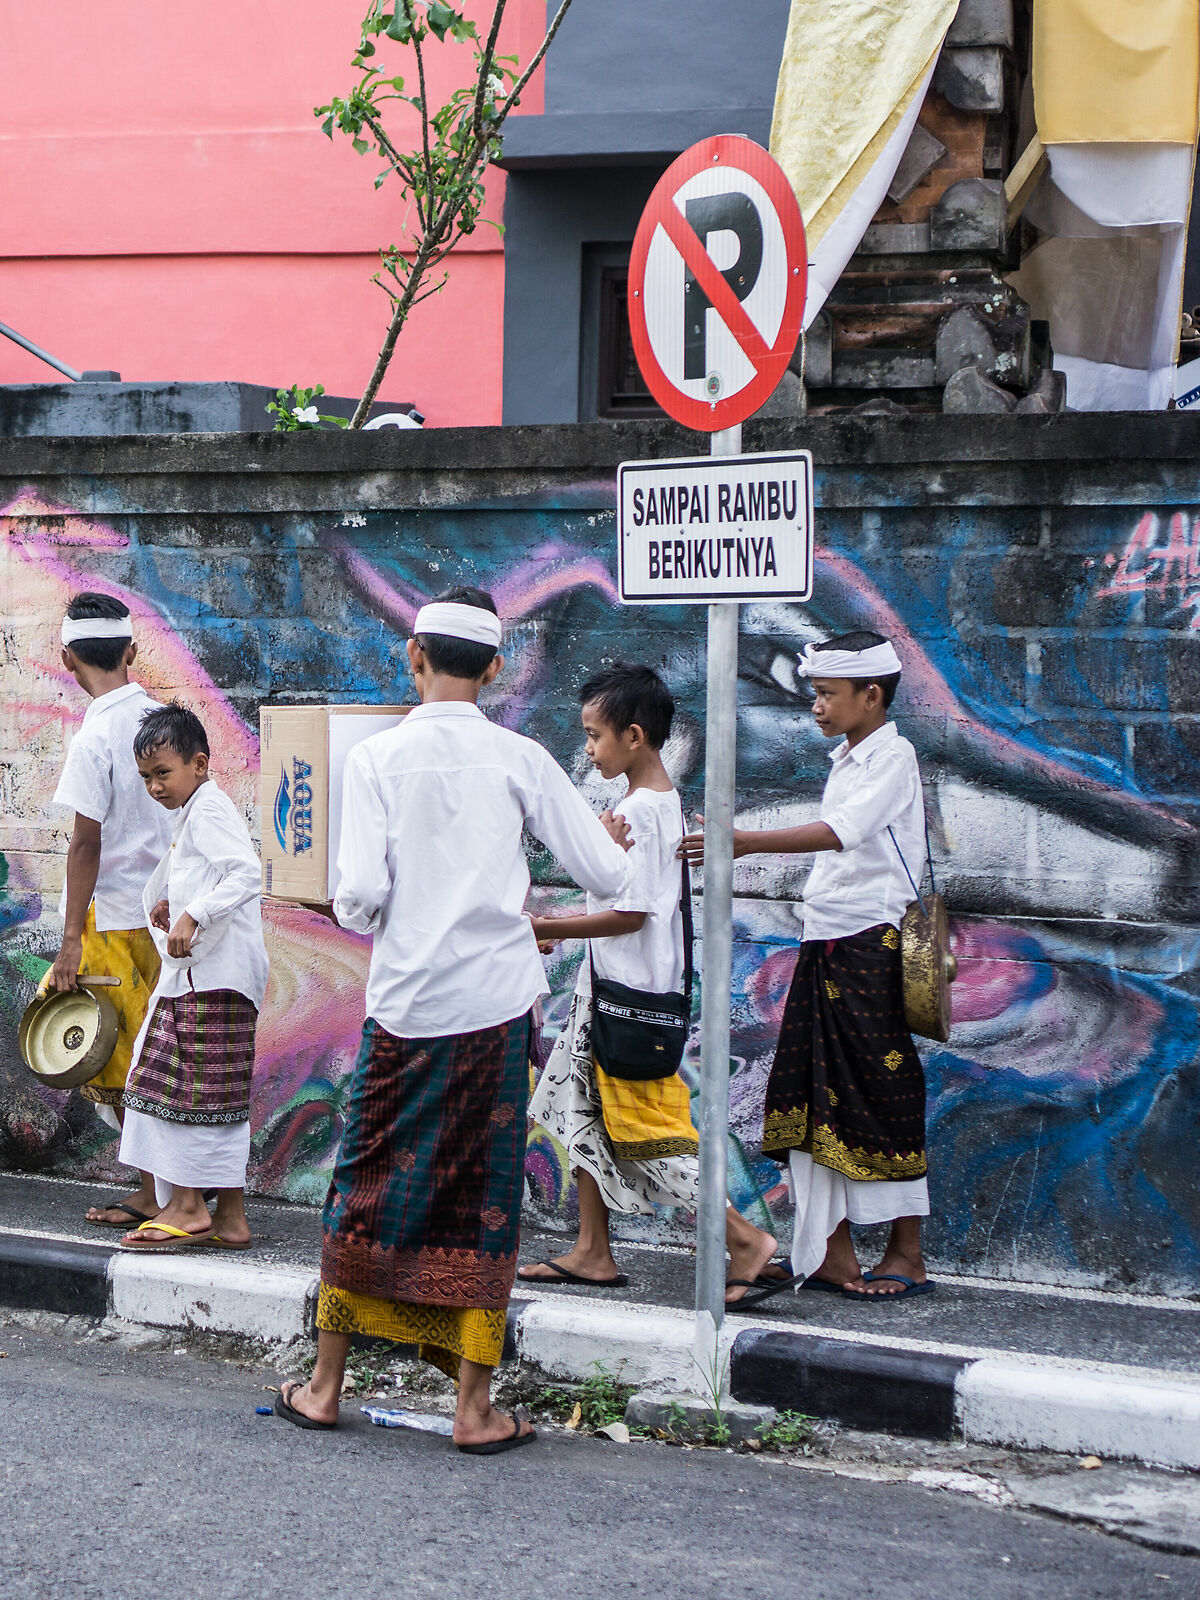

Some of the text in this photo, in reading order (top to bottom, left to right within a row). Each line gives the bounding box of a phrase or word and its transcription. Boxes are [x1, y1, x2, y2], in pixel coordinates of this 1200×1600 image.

[684, 191, 763, 380] P
[633, 480, 797, 526] SAMPAI RAMBU
[648, 536, 778, 579] BERIKUTNYA
[291, 755, 314, 857] AQUA
[599, 1001, 631, 1017] OFF-WHITE
